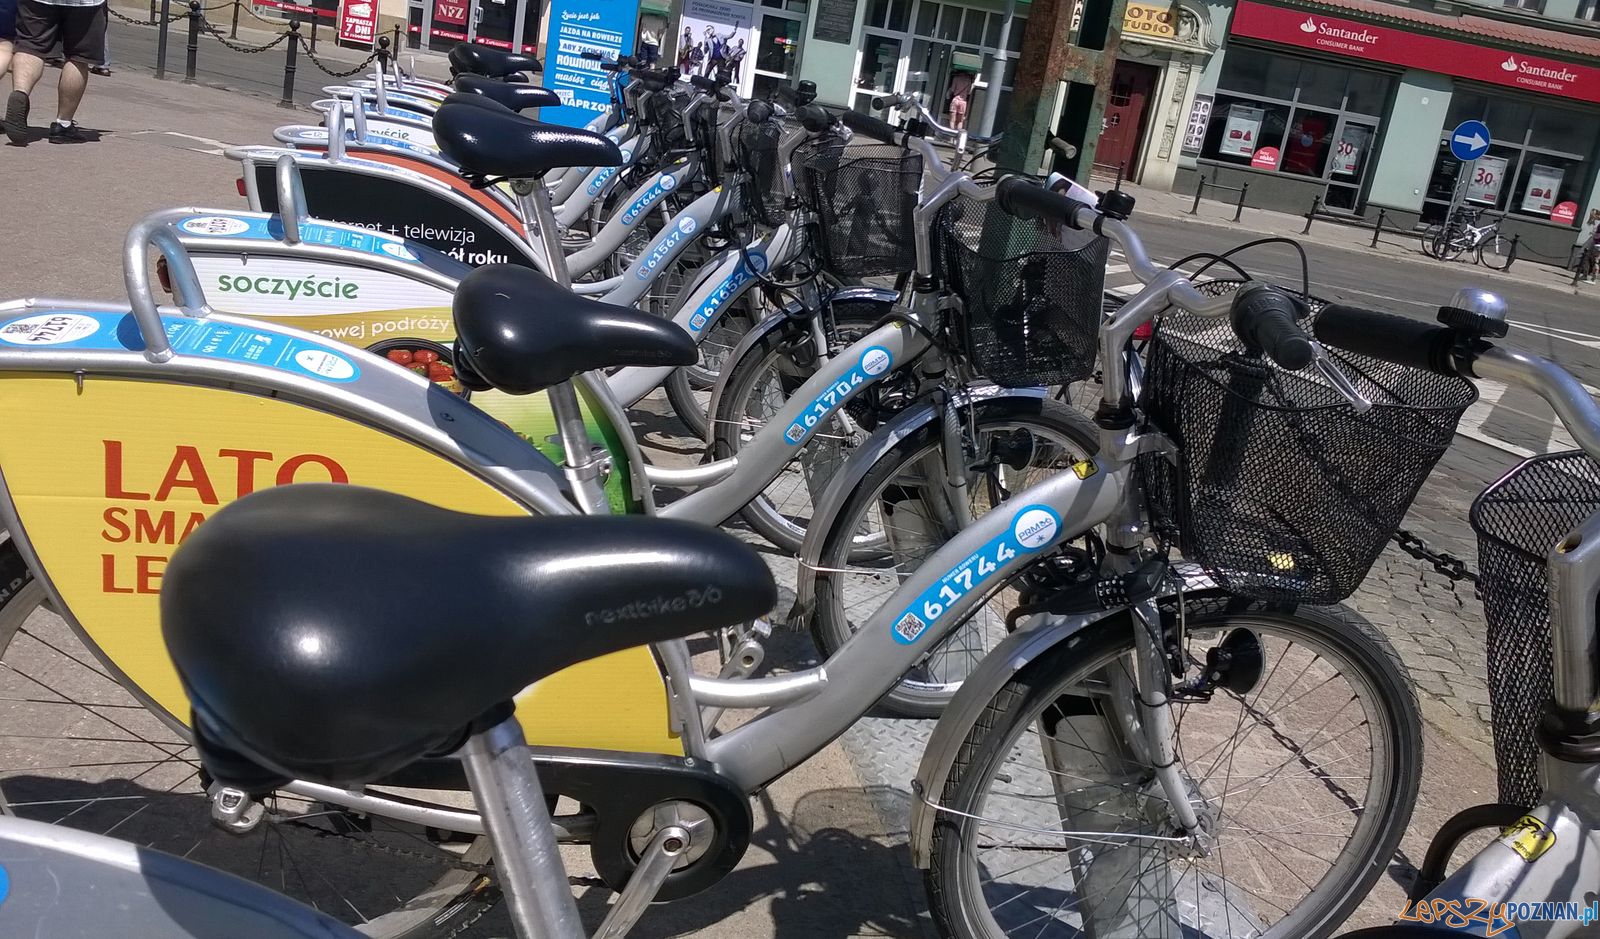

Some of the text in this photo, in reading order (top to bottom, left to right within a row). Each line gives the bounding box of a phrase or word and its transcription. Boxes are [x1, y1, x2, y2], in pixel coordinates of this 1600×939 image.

[345, 17, 373, 26] ZAPRASZA
[1128, 7, 1172, 23] OTO
[346, 23, 371, 35] 7 DNI
[560, 25, 622, 43] JAZDA NA ROWERZE
[1124, 20, 1170, 33] TUDIO
[1318, 22, 1379, 44] Santander
[562, 43, 615, 58] ABY ZACHOWAĆ
[1316, 38, 1364, 52] CONSUMER BANK
[1518, 61, 1578, 82] Santander
[1516, 76, 1564, 90] CONSUMER BANK
[631, 186, 662, 217] 61644
[403, 223, 475, 246] telewizja
[468, 249, 508, 264] roku
[648, 231, 680, 269] 61567
[218, 274, 360, 300] soczyście
[703, 272, 748, 317] 61652
[28, 316, 73, 342] 61744
[372, 316, 449, 336] podróży
[804, 372, 864, 427] 61704
[101, 506, 208, 545] SMA
[101, 553, 168, 595] LE
[924, 542, 1016, 620] 61744
